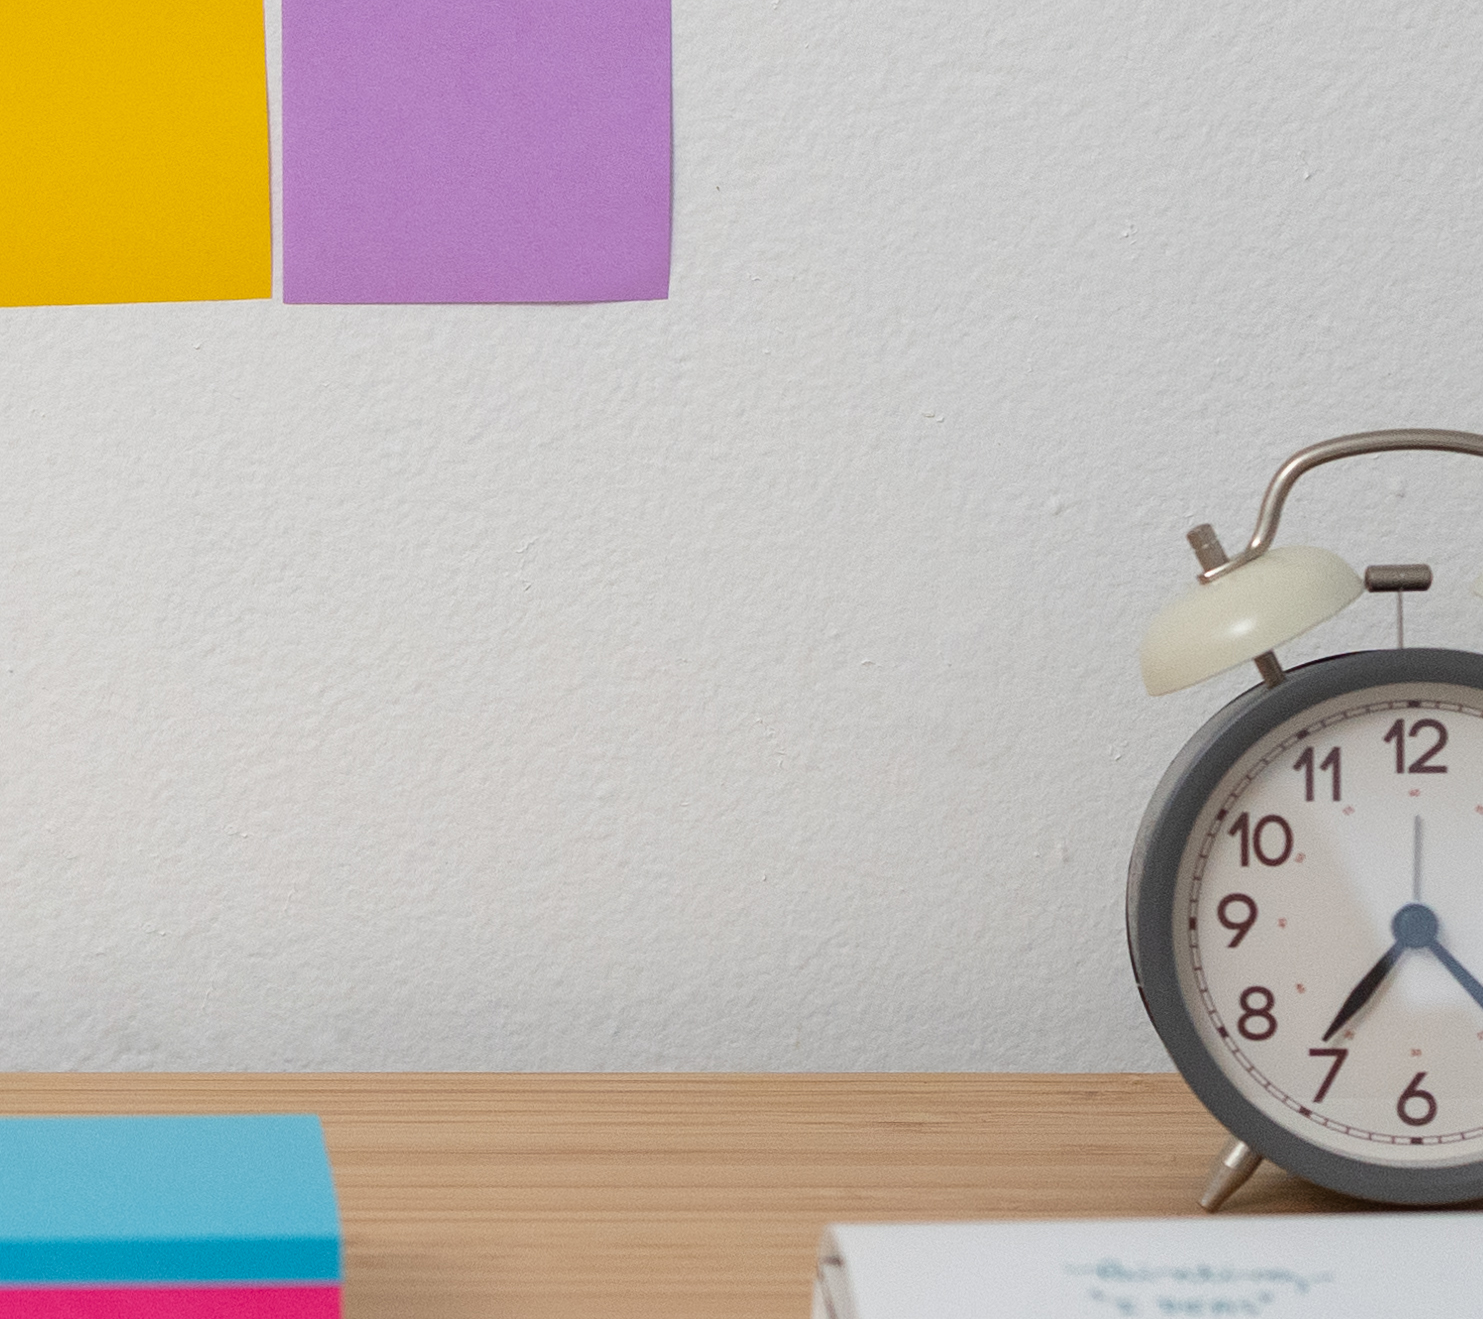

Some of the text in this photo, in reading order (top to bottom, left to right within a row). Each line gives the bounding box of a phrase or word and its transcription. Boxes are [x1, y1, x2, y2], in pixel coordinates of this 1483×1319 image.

[1292, 745, 1342, 802] 11
[1383, 717, 1449, 774] 12
[1227, 811, 1294, 867] 10
[1216, 892, 1259, 948] 9
[1236, 985, 1278, 1042] 8
[1308, 1047, 1349, 1104] 7
[1396, 1071, 1438, 1127] 6
